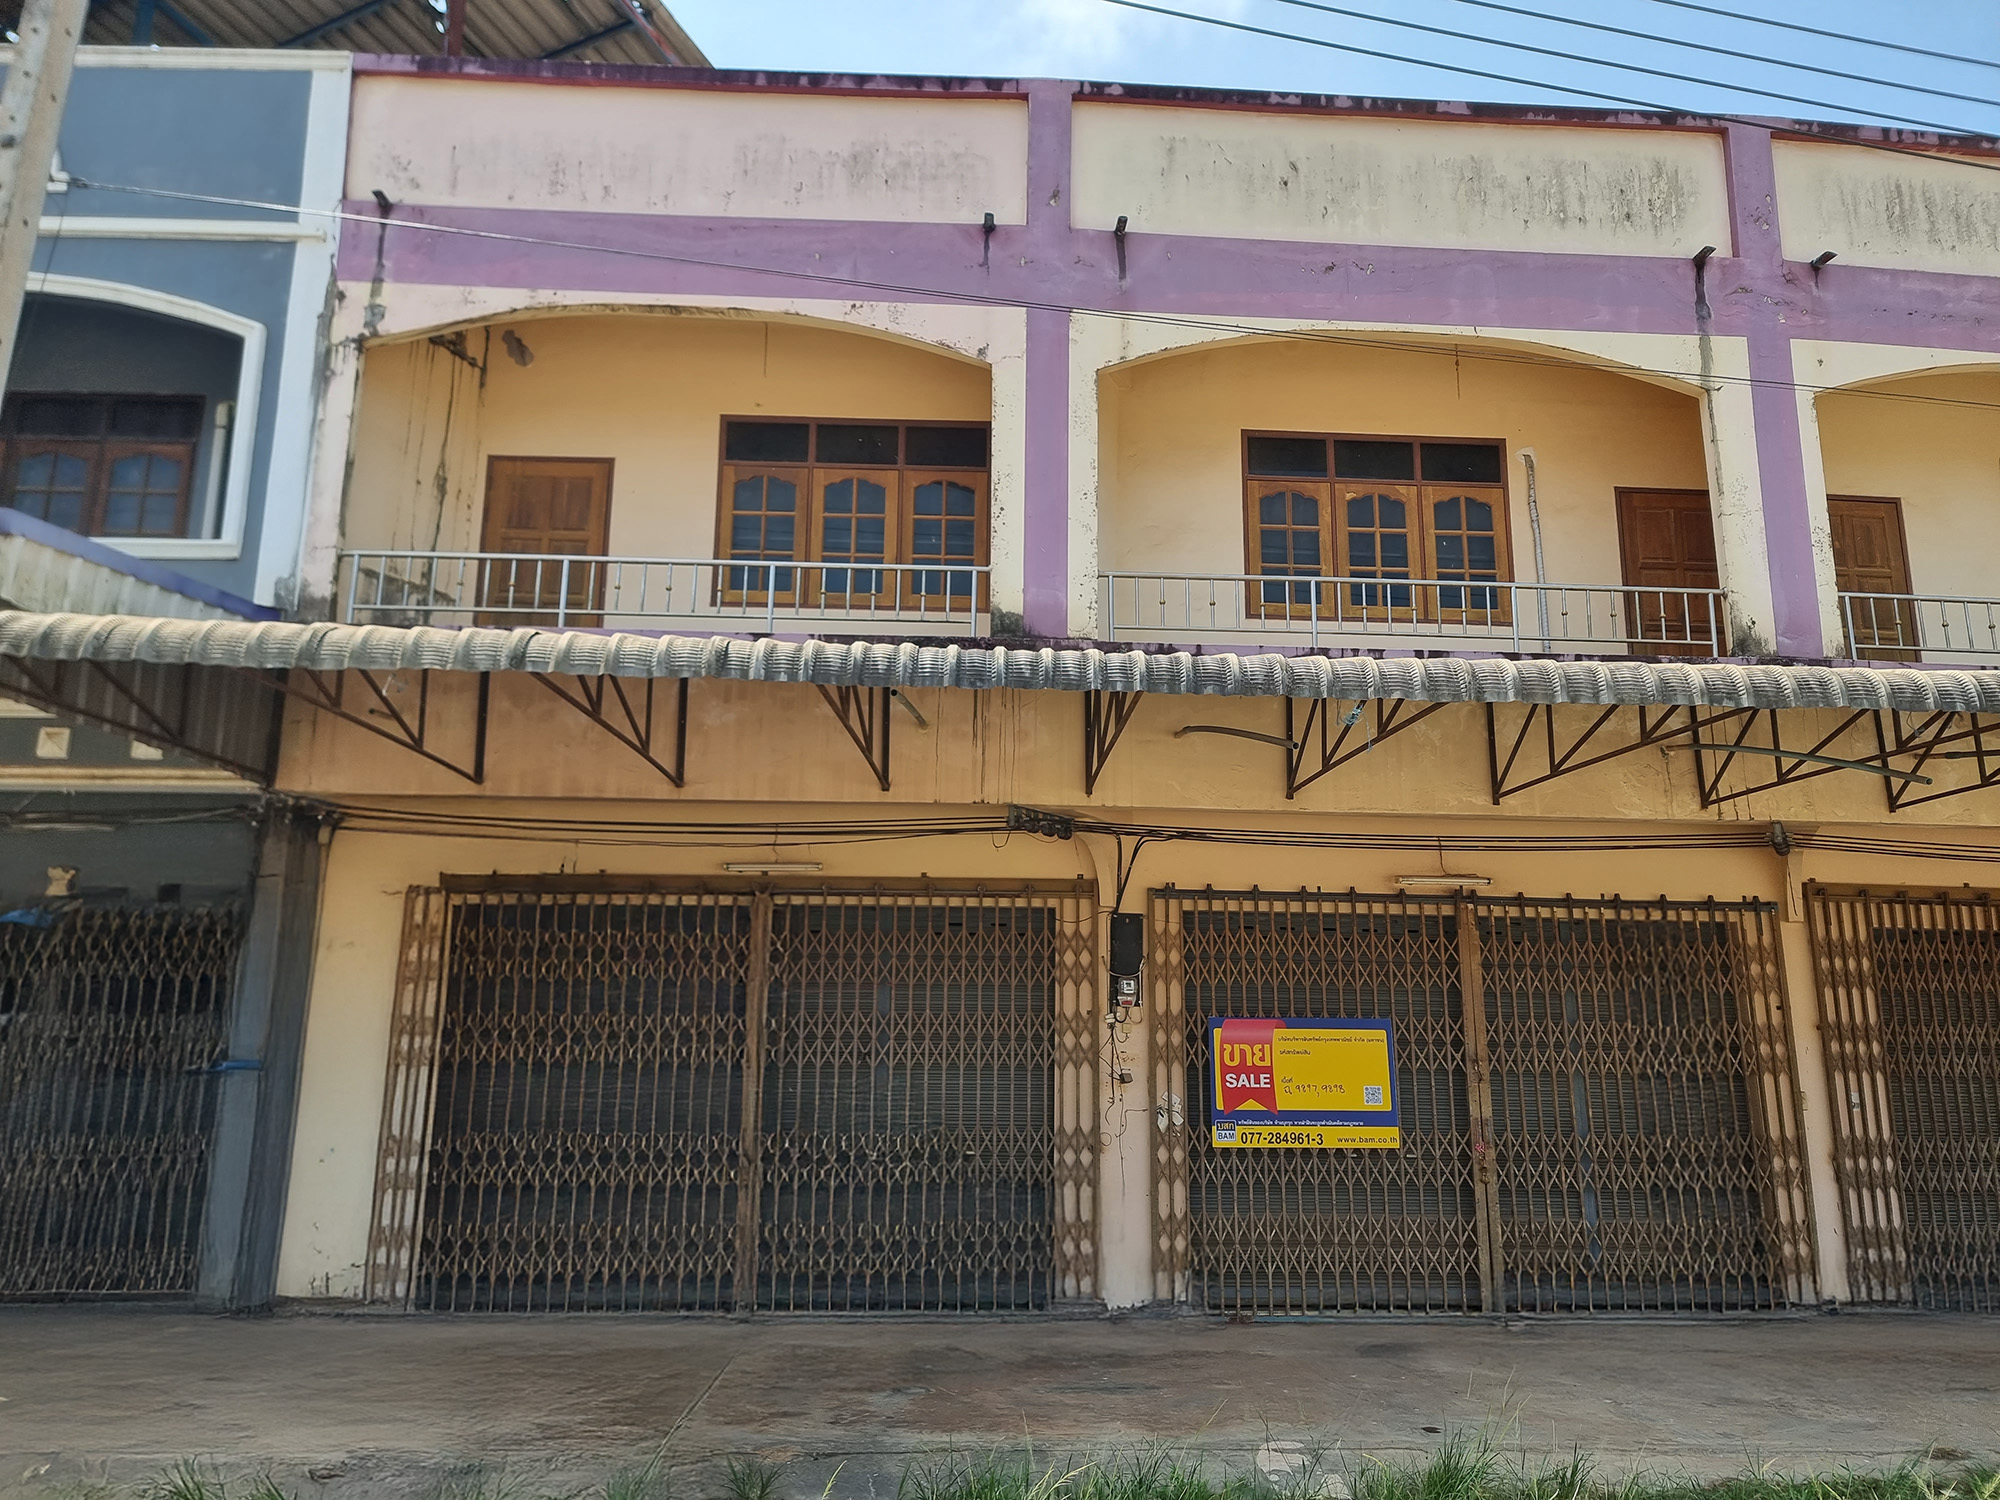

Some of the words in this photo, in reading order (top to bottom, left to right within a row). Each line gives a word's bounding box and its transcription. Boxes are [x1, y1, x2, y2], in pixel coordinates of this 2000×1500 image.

[1223, 1043, 1271, 1067] ขาย
[1225, 1073, 1271, 1088] SALE
[1218, 1132, 1235, 1140] BAM
[1240, 1131, 1324, 1146] 077-284961-3
[1337, 1136, 1398, 1144] www.bam.co.th
